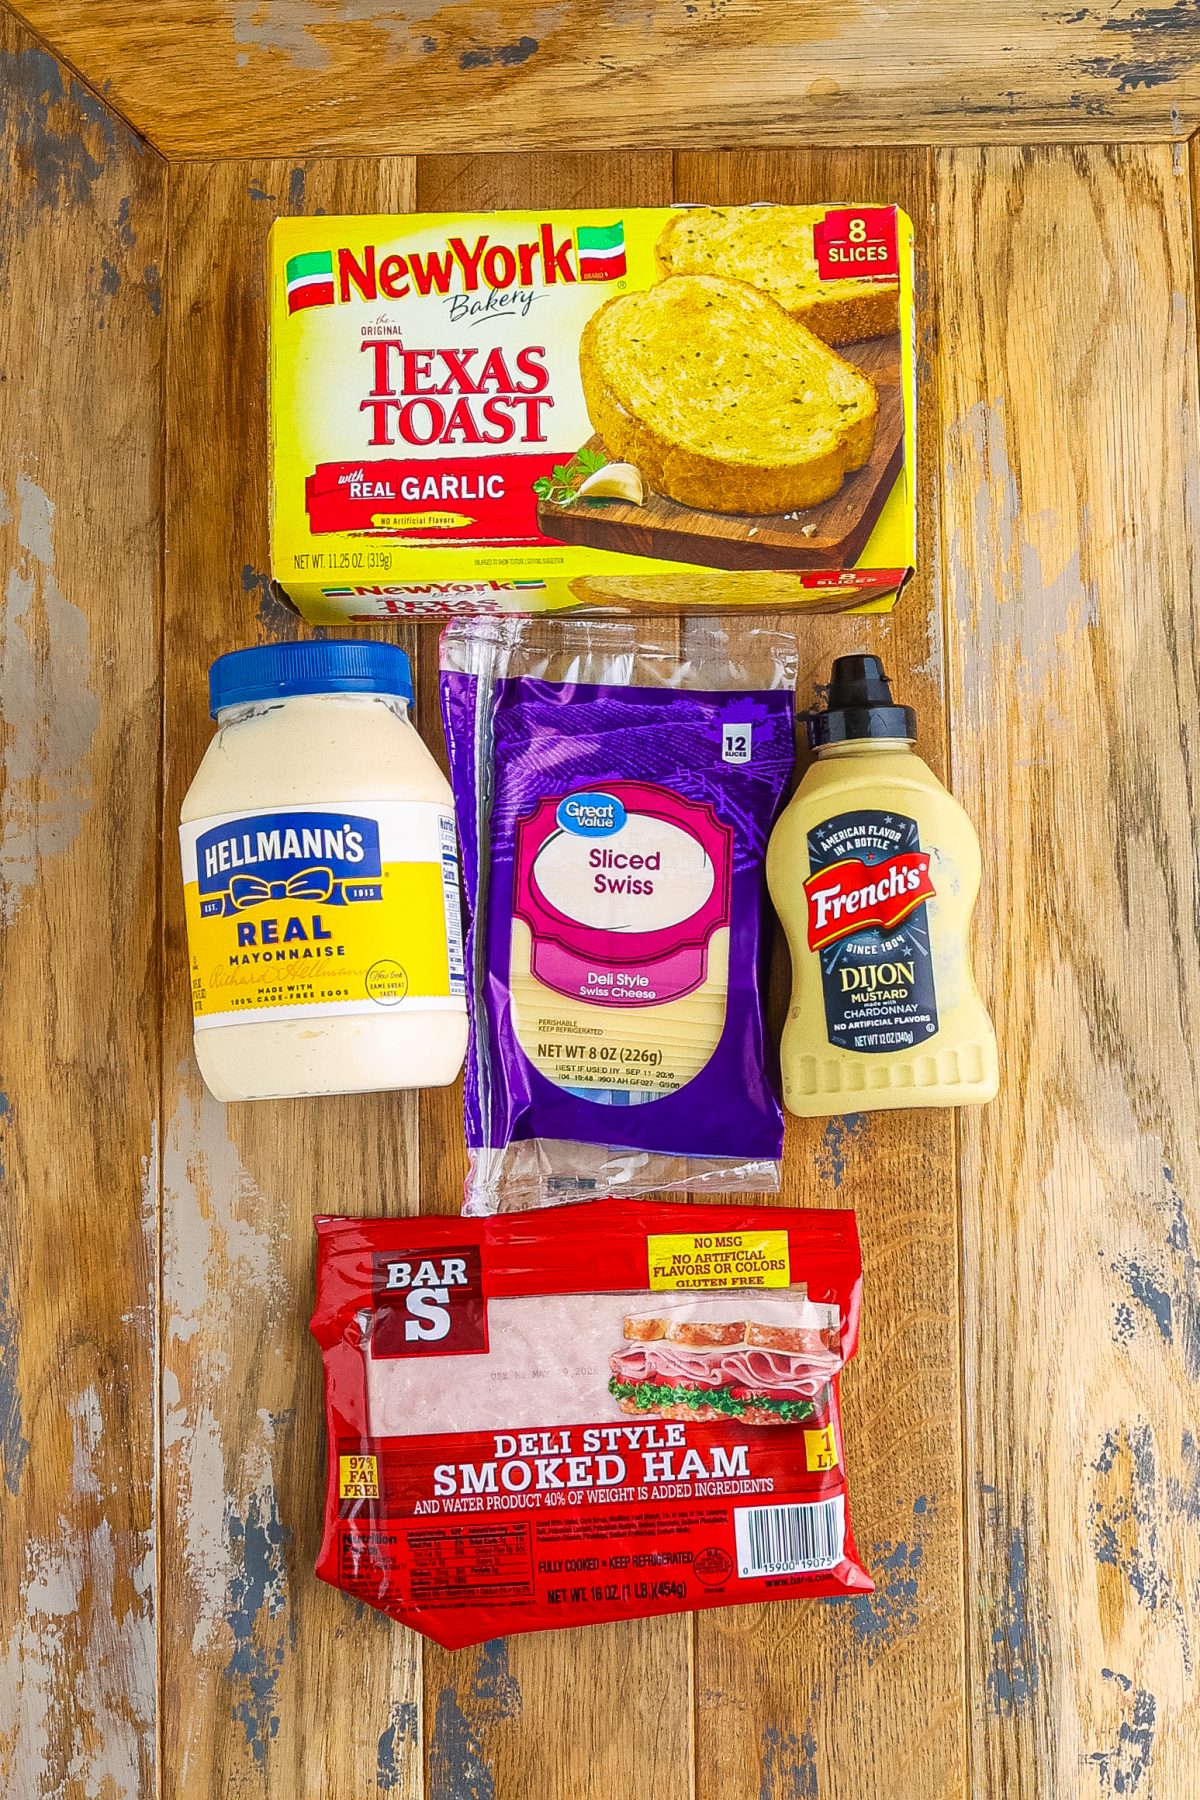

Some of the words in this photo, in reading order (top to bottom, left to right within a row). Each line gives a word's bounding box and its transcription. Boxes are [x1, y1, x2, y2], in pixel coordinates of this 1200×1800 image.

[849, 219, 866, 242] 8
[337, 223, 577, 302] NewYork
[829, 247, 888, 262] SLICES
[443, 288, 549, 318] Bakery
[376, 314, 389, 325] the
[361, 326, 402, 336] ORIGINAL
[361, 340, 549, 397] TEXAS
[359, 396, 555, 446] TOAST
[337, 468, 364, 485] with
[350, 482, 395, 498] REAL
[401, 475, 504, 500] GARLIC
[393, 517, 425, 525] Artificial
[429, 516, 455, 524] Flavors
[294, 554, 310, 569] NET
[312, 554, 326, 568] WT.
[329, 553, 350, 568] 11.25
[367, 552, 392, 570] (319g)
[725, 737, 747, 750] 12
[565, 802, 614, 818] Great
[577, 815, 614, 828] Value
[820, 825, 866, 851] AMERICAN
[868, 825, 902, 842] FLAVOR
[834, 845, 845, 856] IN
[847, 842, 854, 851] A
[855, 837, 890, 851] BOTTLE
[205, 823, 364, 878] HELLMANN'S
[588, 849, 661, 871] Sliced
[593, 874, 654, 896] Swiss
[205, 903, 218, 913] EST.
[353, 888, 375, 898] 1913
[810, 864, 921, 929] French's
[237, 915, 331, 947] REAL
[846, 943, 877, 955] SINCE
[880, 935, 905, 953] 1904
[229, 946, 345, 965] MAYONNAISE
[587, 972, 615, 985] Deli
[616, 973, 649, 988] Style
[839, 961, 915, 992] DIJON
[257, 992, 315, 1002] CAGE-FREE
[321, 989, 349, 997] EGGS
[258, 986, 283, 994] MADE
[287, 984, 313, 992] WITH
[579, 986, 609, 997] Swiss
[611, 987, 656, 1000] Cheese
[851, 989, 908, 1003] MUSTARD
[844, 1004, 918, 1019] CHARDONNAY
[538, 1019, 578, 1027] PERISHABLE
[556, 1027, 603, 1035] REFRIGERATED
[848, 1019, 891, 1029] ARTIFICIAL
[894, 1015, 931, 1025] FLAVORS
[854, 1034, 867, 1047] NET
[867, 1034, 878, 1045] WT
[879, 1033, 886, 1044] 12
[886, 1032, 895, 1044] OZ
[895, 1031, 913, 1044] (340g)
[537, 1044, 565, 1058] NET
[565, 1045, 585, 1059] WT
[588, 1047, 596, 1059] 8
[600, 1047, 617, 1061] OZ
[619, 1048, 663, 1066] (226g)
[694, 1237, 712, 1249] NO
[715, 1236, 742, 1248] MSG
[672, 1254, 691, 1264] NO
[695, 1251, 766, 1263] ARTIFICIAL
[386, 1258, 468, 1289] BAR
[653, 1263, 710, 1277] FLAVORS
[714, 1262, 731, 1274] OR
[735, 1260, 785, 1273] COLORS
[676, 1278, 727, 1288] GLUTEN
[731, 1276, 764, 1286] FREE
[405, 1287, 450, 1342] S
[493, 1430, 571, 1459] DELI
[583, 1423, 686, 1452] STYLE
[821, 1431, 831, 1451] 1
[350, 1457, 373, 1469] 97%
[434, 1454, 627, 1496] SMOKED
[641, 1446, 750, 1482] HAM
[349, 1471, 374, 1483] FAT
[343, 1485, 377, 1497] FREE
[413, 1500, 439, 1515] AND
[442, 1497, 484, 1512] WATER
[486, 1493, 542, 1510] PRODUCT
[544, 1492, 565, 1506] 40%
[567, 1490, 583, 1505] OF
[586, 1487, 635, 1504] WEIGHT
[637, 1486, 649, 1499] IS
[651, 1482, 692, 1499] ADDED
[695, 1478, 774, 1497] INGREDIENTS
[538, 1560, 562, 1573] FULLY
[565, 1558, 598, 1572] COOKED
[609, 1556, 630, 1569] KEEP
[633, 1552, 693, 1568] REFRIGERATED
[743, 1567, 749, 1575] 0
[764, 1561, 795, 1573] 15900
[801, 1557, 832, 1569] 19075
[547, 1589, 567, 1604] NET
[591, 1586, 603, 1600] 16
